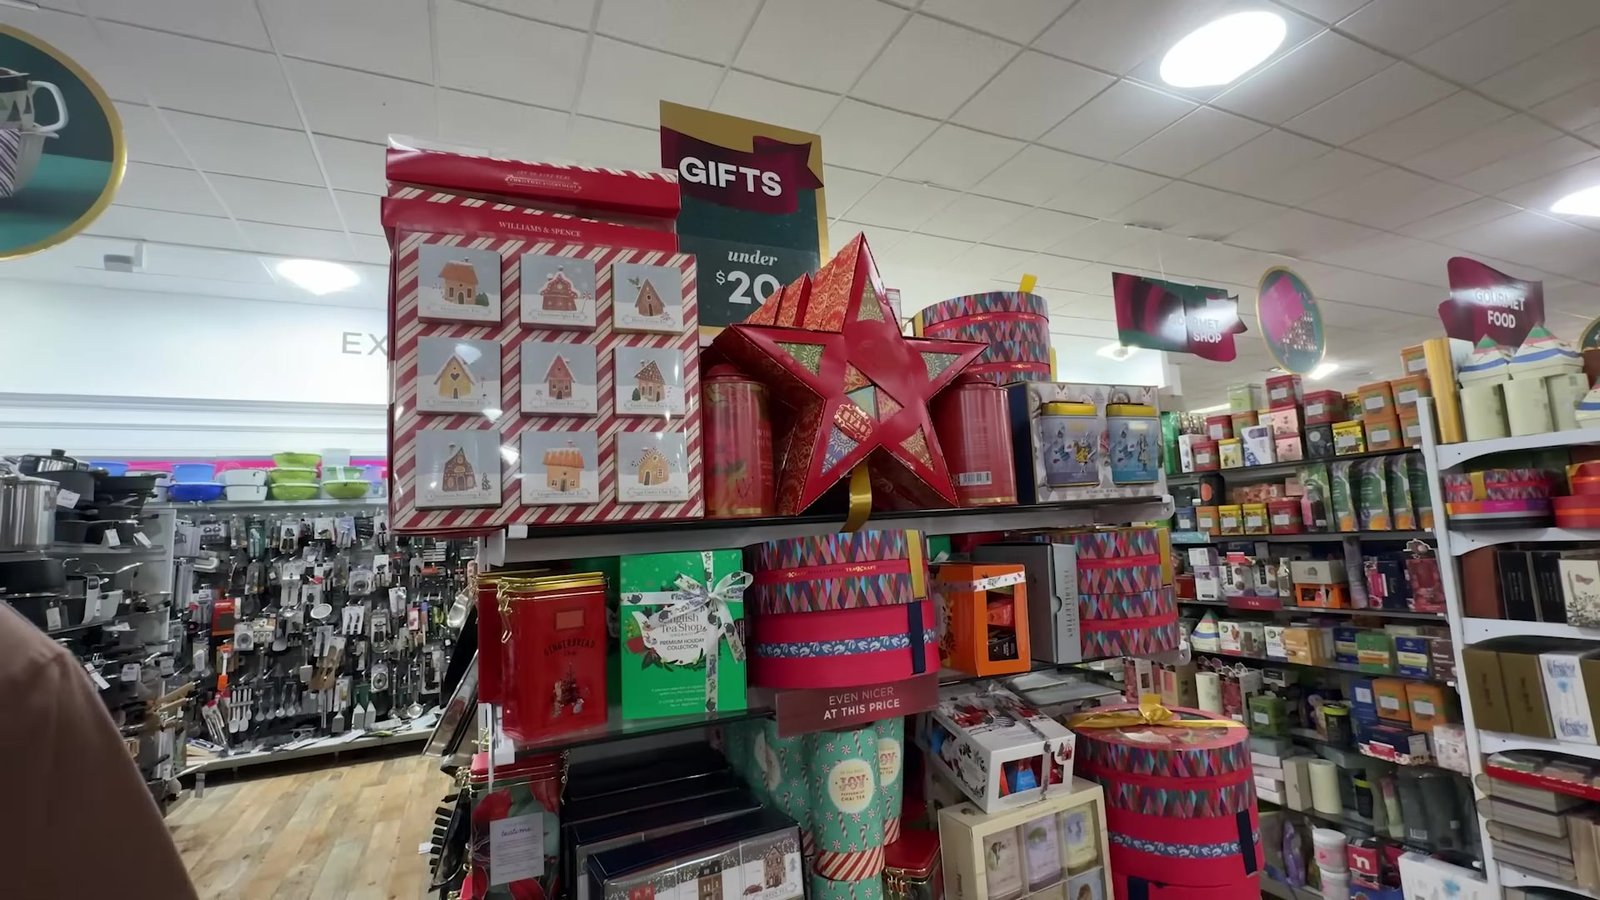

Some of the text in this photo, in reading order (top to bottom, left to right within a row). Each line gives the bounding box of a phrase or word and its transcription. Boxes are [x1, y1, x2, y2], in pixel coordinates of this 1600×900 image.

[679, 156, 783, 197] GIFTS
[499, 221, 542, 233] WILLIAMS
[551, 227, 581, 237] SPENCE
[727, 250, 778, 266] under
[716, 269, 781, 305] $20
[1487, 310, 1516, 329] FOOD
[1193, 331, 1222, 344] SHOP
[664, 613, 699, 625] nglish
[829, 686, 894, 706] EVEN NICER
[823, 698, 900, 720] AT THIS PRICE
[839, 774, 866, 791] JOY
